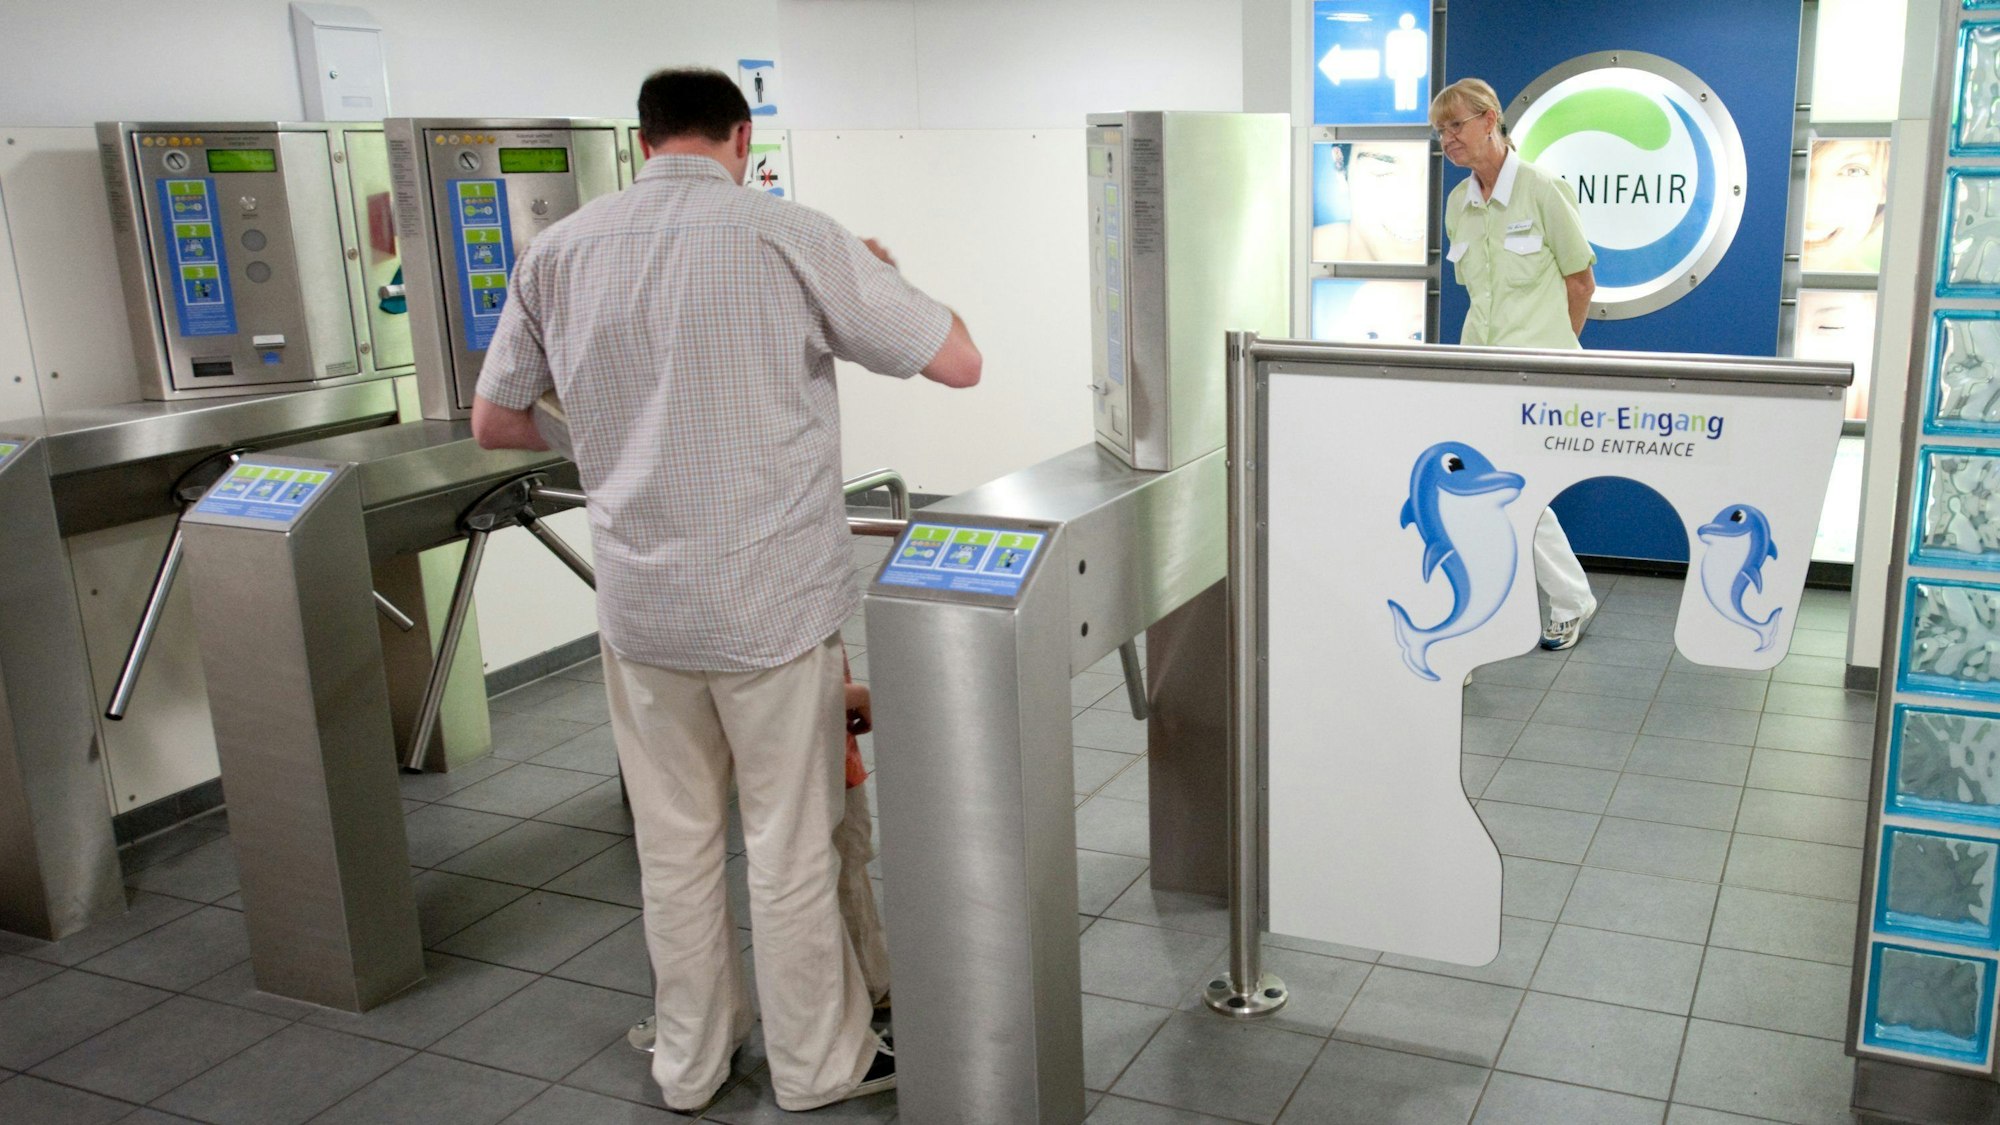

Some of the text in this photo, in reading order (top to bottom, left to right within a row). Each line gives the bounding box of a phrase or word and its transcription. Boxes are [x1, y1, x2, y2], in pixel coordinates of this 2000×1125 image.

[474, 185, 481, 196] 1
[1561, 174, 1686, 204] NIFAIR
[189, 226, 197, 235] 2
[479, 231, 487, 241] 2
[196, 268, 205, 277] 3
[485, 277, 492, 287] 3
[1521, 402, 1724, 440] Kinder-Eingang
[1544, 436, 1696, 457] CHILD ENTRANCE
[927, 529, 1023, 547] 1 2 3
